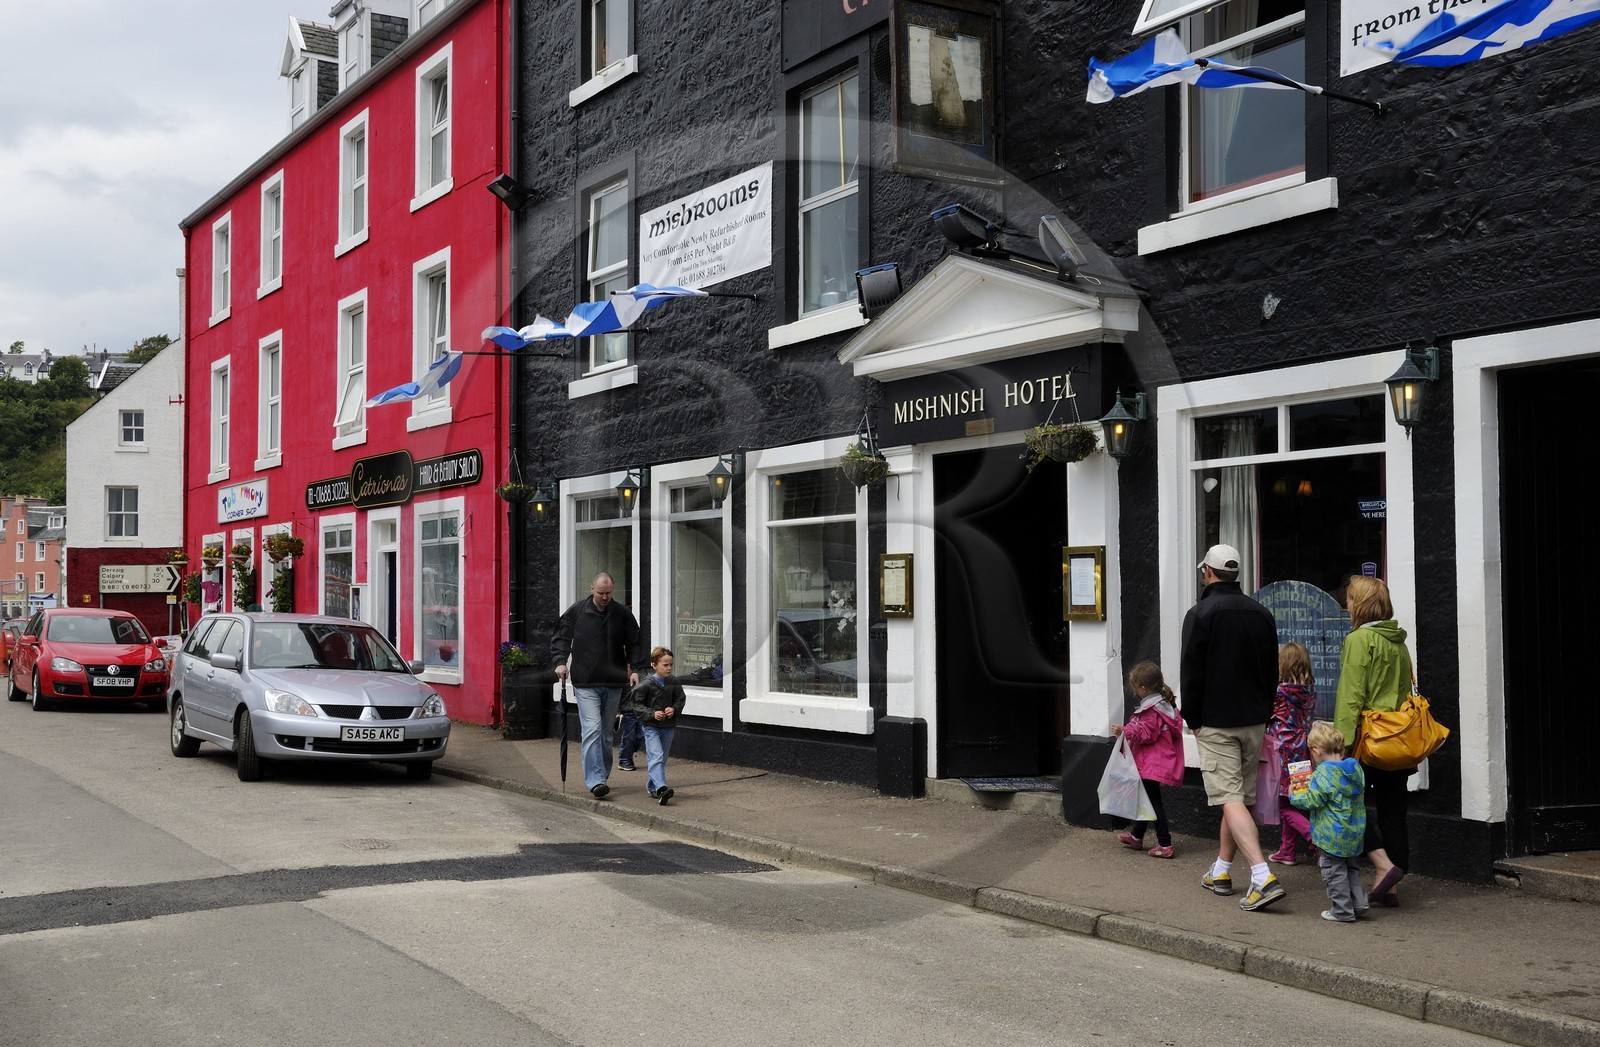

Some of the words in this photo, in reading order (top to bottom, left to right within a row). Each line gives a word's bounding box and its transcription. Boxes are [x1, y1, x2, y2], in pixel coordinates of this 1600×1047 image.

[653, 238, 690, 259] Comfortable
[691, 232, 708, 246] Newly
[709, 217, 744, 239] Refurbished
[744, 210, 766, 225] Rooms
[666, 257, 683, 268] From
[683, 249, 693, 263] £65
[694, 248, 705, 259] Per
[706, 241, 722, 255] Night
[677, 276, 688, 288] Tel:
[688, 269, 706, 283] 01688
[706, 261, 726, 278] 302704
[893, 387, 985, 426] MISHNISH
[1004, 373, 1077, 408] HOTEL
[419, 465, 432, 486] HAIR
[433, 463, 438, 484] &
[439, 459, 458, 482] BEAUTY
[458, 455, 477, 479] SALON
[331, 481, 349, 501] 302234
[245, 507, 257, 516] SHOP
[1314, 656, 1337, 670] the
[346, 728, 377, 740] SA56
[379, 728, 400, 740] AKG
